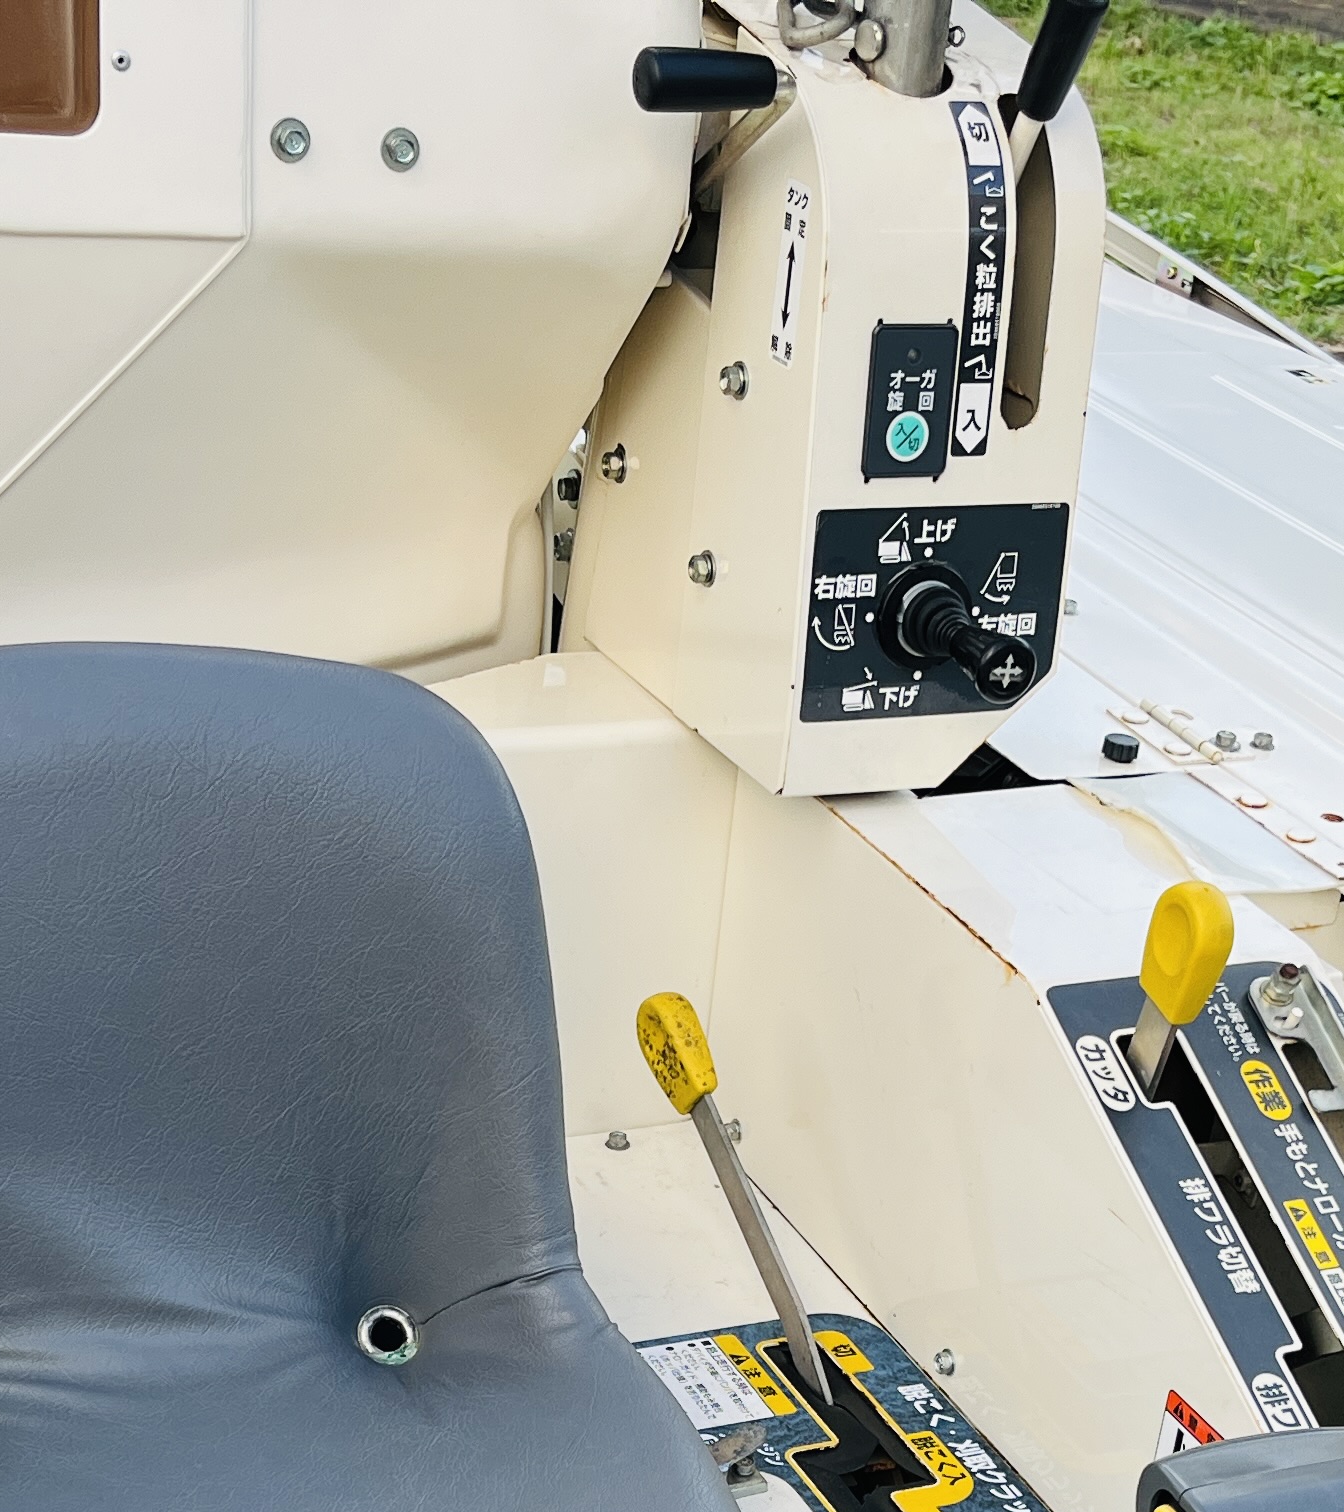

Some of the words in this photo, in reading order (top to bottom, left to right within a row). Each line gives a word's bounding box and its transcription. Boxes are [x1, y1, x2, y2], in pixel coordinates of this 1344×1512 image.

[967, 120, 991, 144] 切
[787, 186, 809, 210] タンク
[969, 205, 999, 347] こく粒排出
[888, 368, 938, 390] オーガ
[886, 390, 935, 412] 旋回
[961, 409, 983, 433] 入
[913, 518, 957, 544] 上げ
[814, 573, 878, 600] 右旋回
[878, 684, 920, 711] 下げ
[1080, 1043, 1131, 1104] カッタ
[1243, 1067, 1289, 1113] 作業
[1178, 1176, 1261, 1294] 排ワラ切替
[831, 1342, 858, 1360] 切
[909, 1434, 972, 1487] 脱こく入
